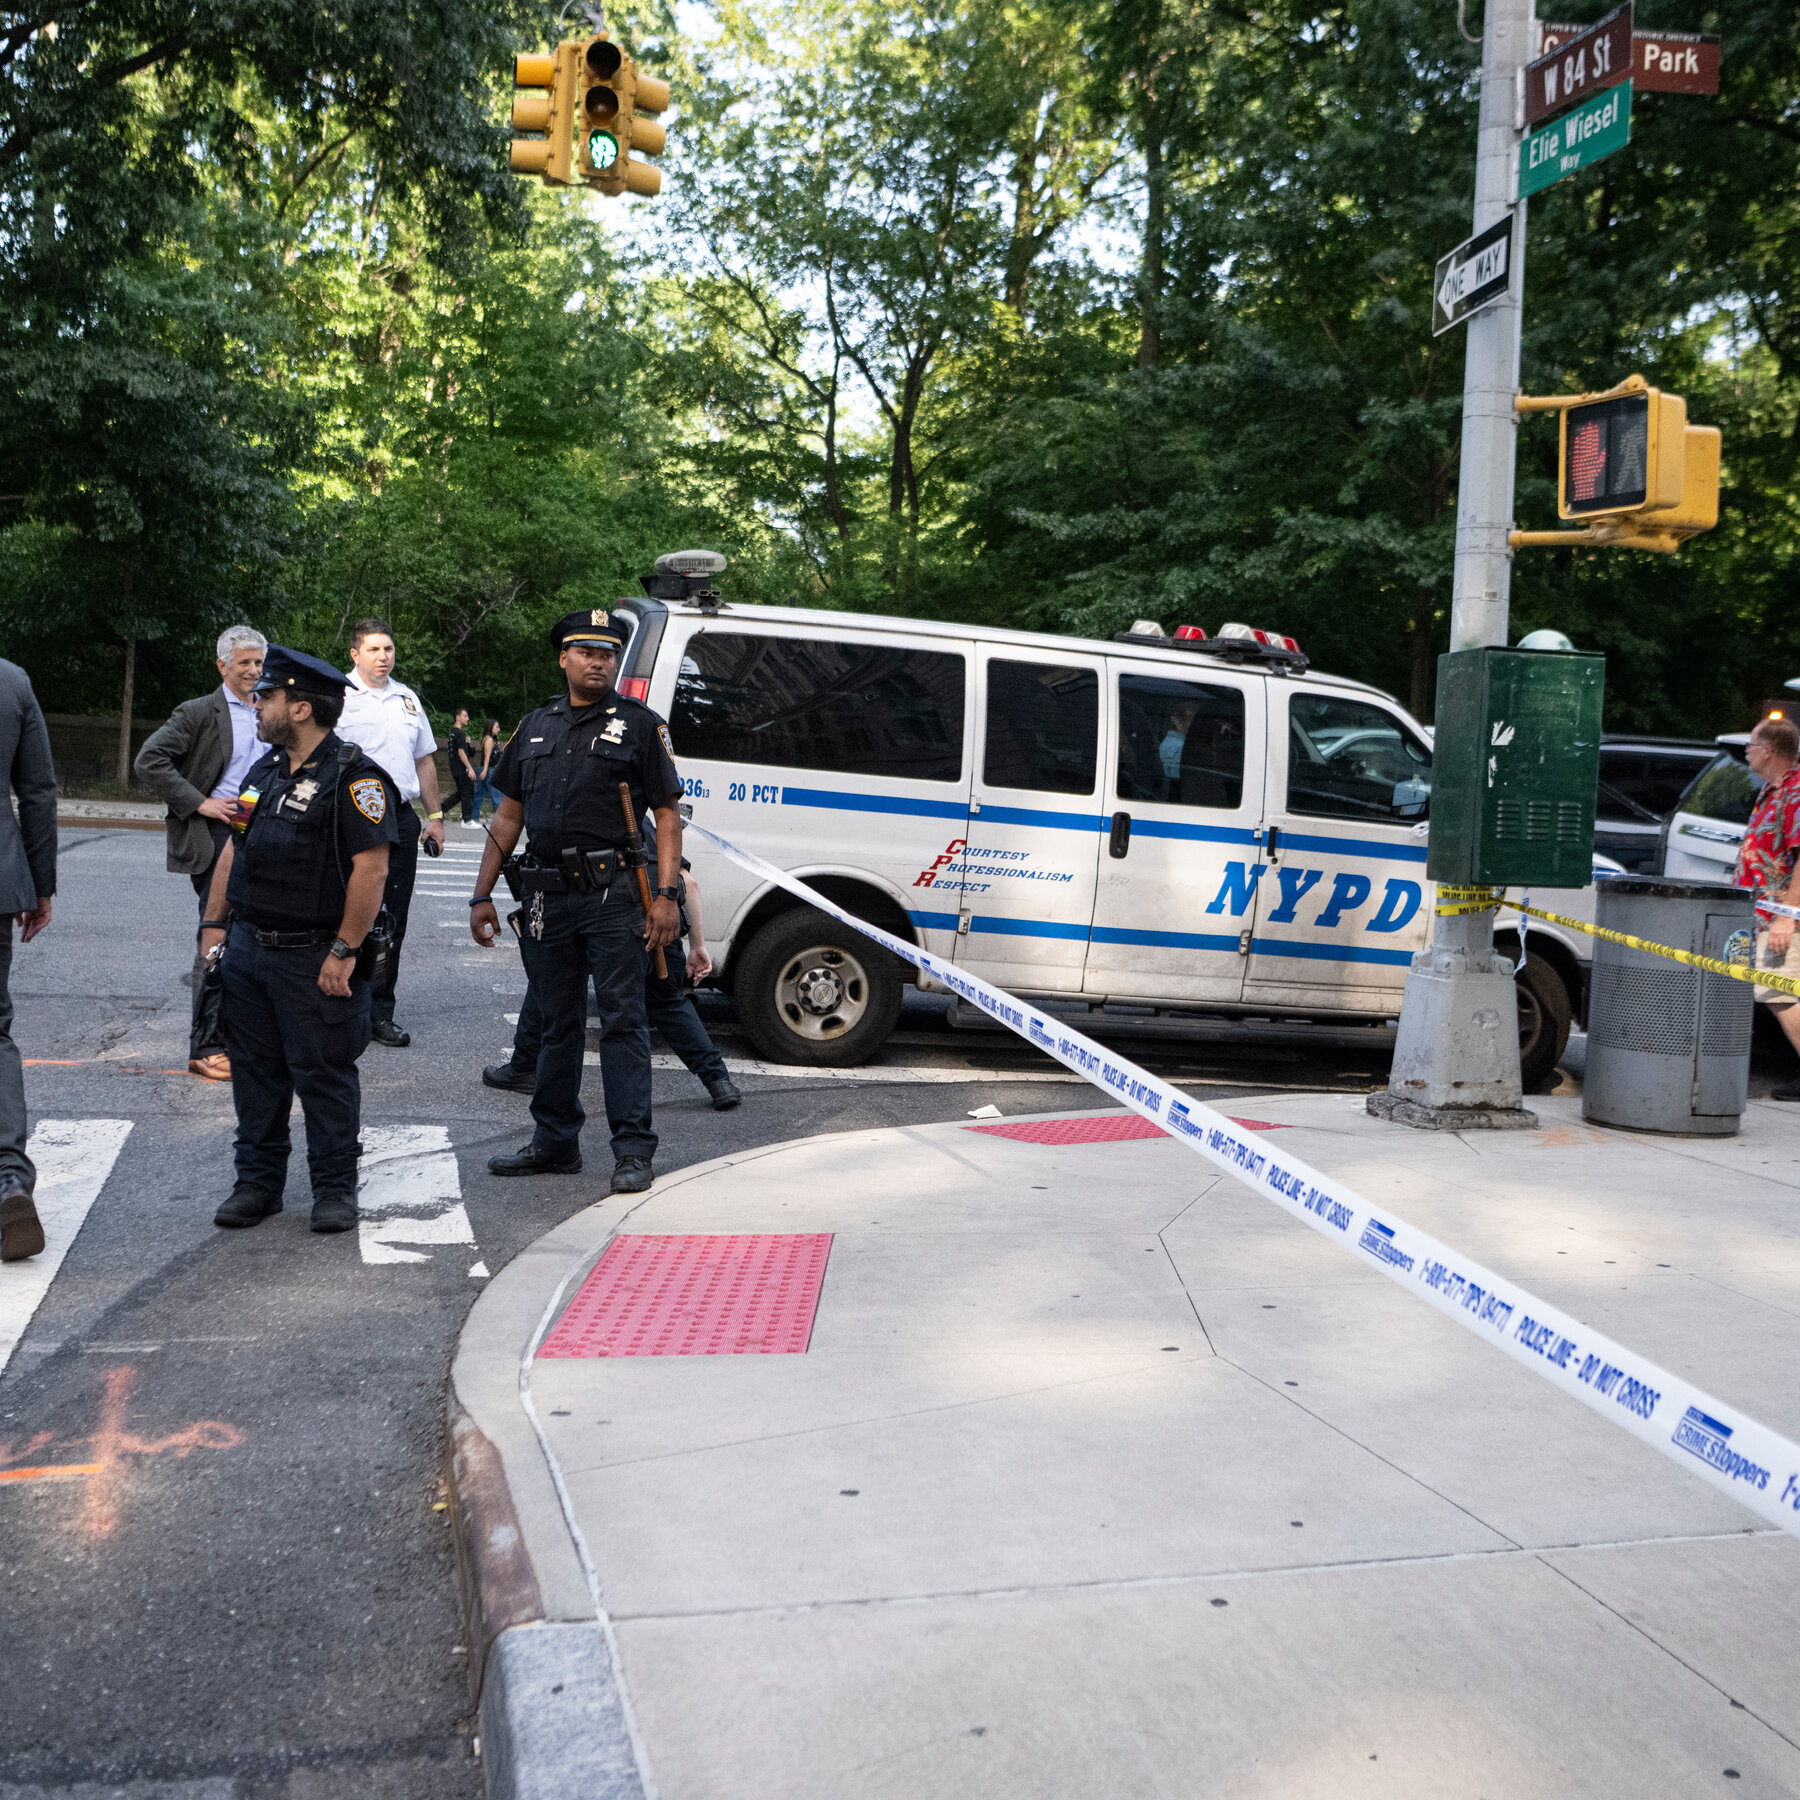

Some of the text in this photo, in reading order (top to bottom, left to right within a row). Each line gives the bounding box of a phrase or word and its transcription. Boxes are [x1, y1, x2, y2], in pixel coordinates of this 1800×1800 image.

[1544, 63, 1559, 106] W
[1564, 47, 1586, 96] 84
[1592, 33, 1612, 78] St
[1644, 43, 1700, 74] Park
[1529, 91, 1618, 170] Elie Wiesel
[1560, 152, 1582, 172] Way
[1444, 244, 1501, 304] ONE WAY
[728, 782, 778, 804] 20 PCT
[929, 855, 1074, 882] PROFESSIONALISM
[945, 839, 1030, 861] COURTESY
[912, 872, 991, 892] RESPECT
[1204, 860, 1422, 933] NYPD
[1266, 1164, 1291, 1193] POLICE
[1286, 1176, 1304, 1201] LINE
[1314, 1193, 1332, 1218] NOT
[1327, 1201, 1354, 1231] CROSS
[1514, 1315, 1554, 1356] POLICE
[1546, 1334, 1577, 1369] LINE
[1577, 1353, 1601, 1384] DO
[1593, 1363, 1624, 1398] NOT
[1616, 1377, 1661, 1420] CROSS
